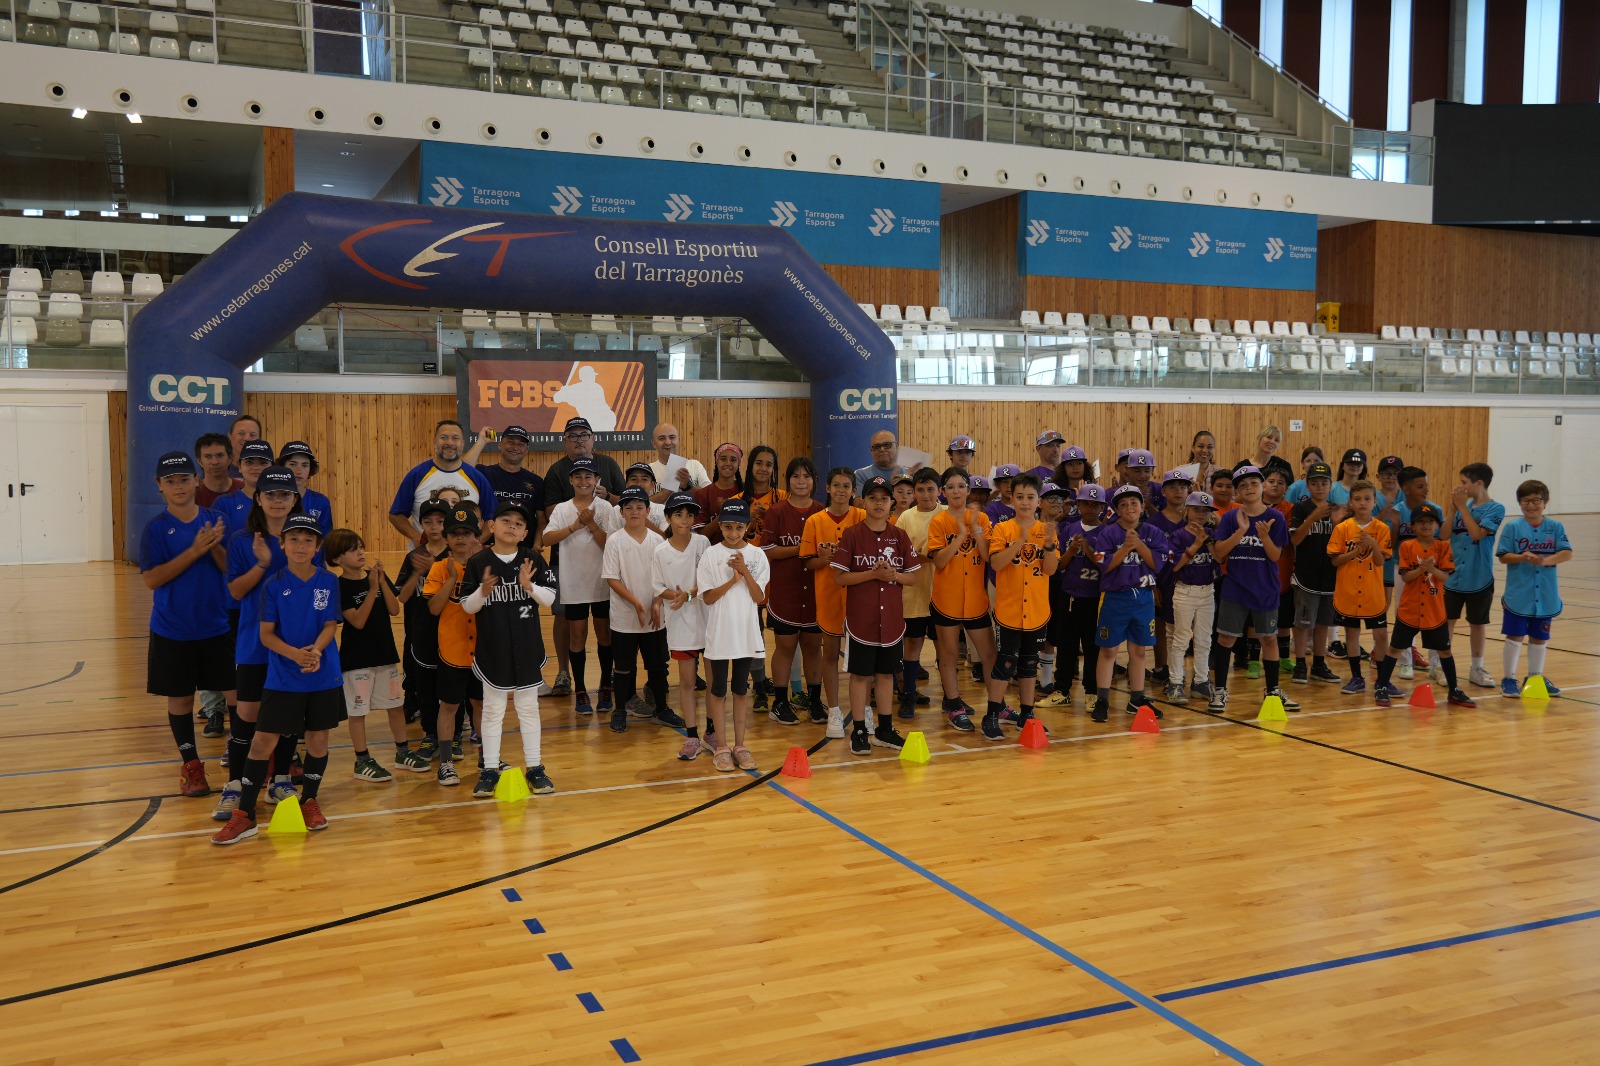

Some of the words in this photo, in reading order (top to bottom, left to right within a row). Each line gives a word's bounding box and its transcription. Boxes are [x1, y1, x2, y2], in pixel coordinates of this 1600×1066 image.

[471, 186, 521, 198] Tarragona
[473, 195, 510, 206] Esports
[590, 195, 636, 206] Tarragona
[591, 203, 626, 213] Esports
[700, 202, 744, 213] Tarragona
[702, 211, 734, 220] Esports
[804, 209, 845, 219] Tarragona
[805, 218, 836, 227] Esports
[901, 216, 940, 227] Tarragona
[902, 224, 931, 233] Esports
[1055, 227, 1089, 237] Tarragona
[1056, 235, 1082, 244] Esports
[1137, 233, 1170, 243] Tarragona
[594, 235, 669, 256] Consell
[676, 238, 759, 262] Esportiu
[1138, 241, 1163, 249] Esports
[1215, 239, 1246, 248] Tarragona
[1215, 247, 1239, 255] Esports
[1289, 251, 1312, 259] Esports
[595, 261, 625, 280] del
[632, 261, 744, 288] Tarragonès
[190, 240, 312, 342] www.cetarragones.cat
[783, 266, 872, 361] www.cetarragones.cat
[150, 373, 229, 405] CCT
[478, 380, 564, 408] FCBS
[839, 387, 894, 412] CCT
[138, 404, 159, 412] Consell
[160, 405, 192, 414] Comarcal
[193, 406, 204, 414] del
[205, 407, 238, 417] Tarragonès
[613, 434, 645, 442] SOFTBOL
[1069, 450, 1077, 458] R
[1137, 455, 1146, 465] R
[1002, 467, 1010, 476] R
[1173, 470, 1182, 479] R
[974, 478, 982, 487] R
[1089, 488, 1098, 498] R
[1200, 494, 1209, 504] R
[1080, 568, 1099, 580] 22
